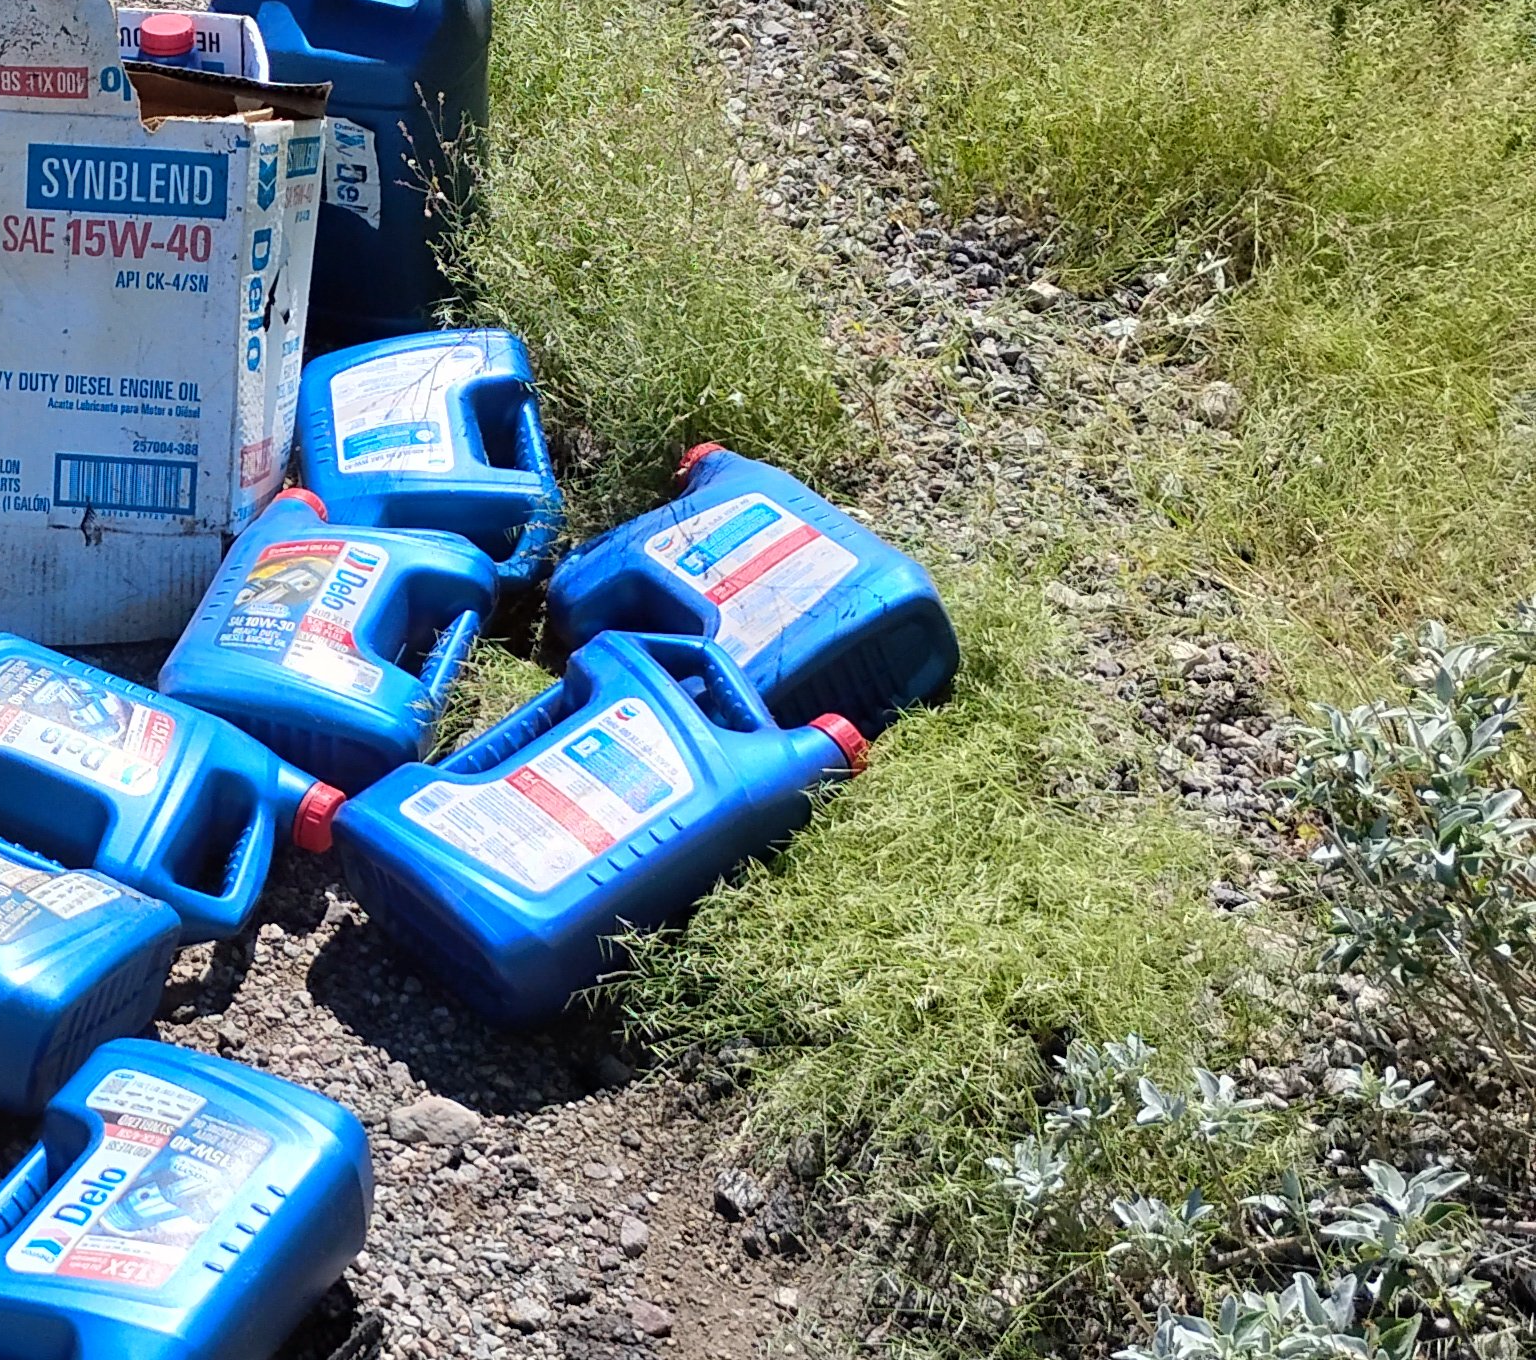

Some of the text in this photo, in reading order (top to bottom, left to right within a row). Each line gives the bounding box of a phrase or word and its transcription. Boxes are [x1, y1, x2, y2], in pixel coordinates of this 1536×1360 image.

[1, 71, 21, 91] SB
[58, 71, 87, 93] 400
[100, 67, 132, 101] lo
[41, 158, 213, 206] SYNBLEND
[2, 215, 212, 263] SAE 15W-40
[115, 270, 209, 293] API CK-4/SN
[246, 227, 272, 372] Delo
[18, 372, 60, 394] DUTY
[65, 374, 114, 397] DIESEL
[120, 378, 174, 400] ENGINE
[178, 382, 202, 402] OIL
[76, 398, 119, 413] Lubricante
[120, 403, 139, 417] para
[141, 403, 166, 417] Motor
[13, 494, 51, 515] GALÓN)
[321, 569, 369, 611] Delo
[245, 616, 295, 632] 10W-30
[118, 1114, 176, 1137] SYNBLEND
[169, 1134, 231, 1168] 15W-40
[52, 1166, 128, 1227] Delo
